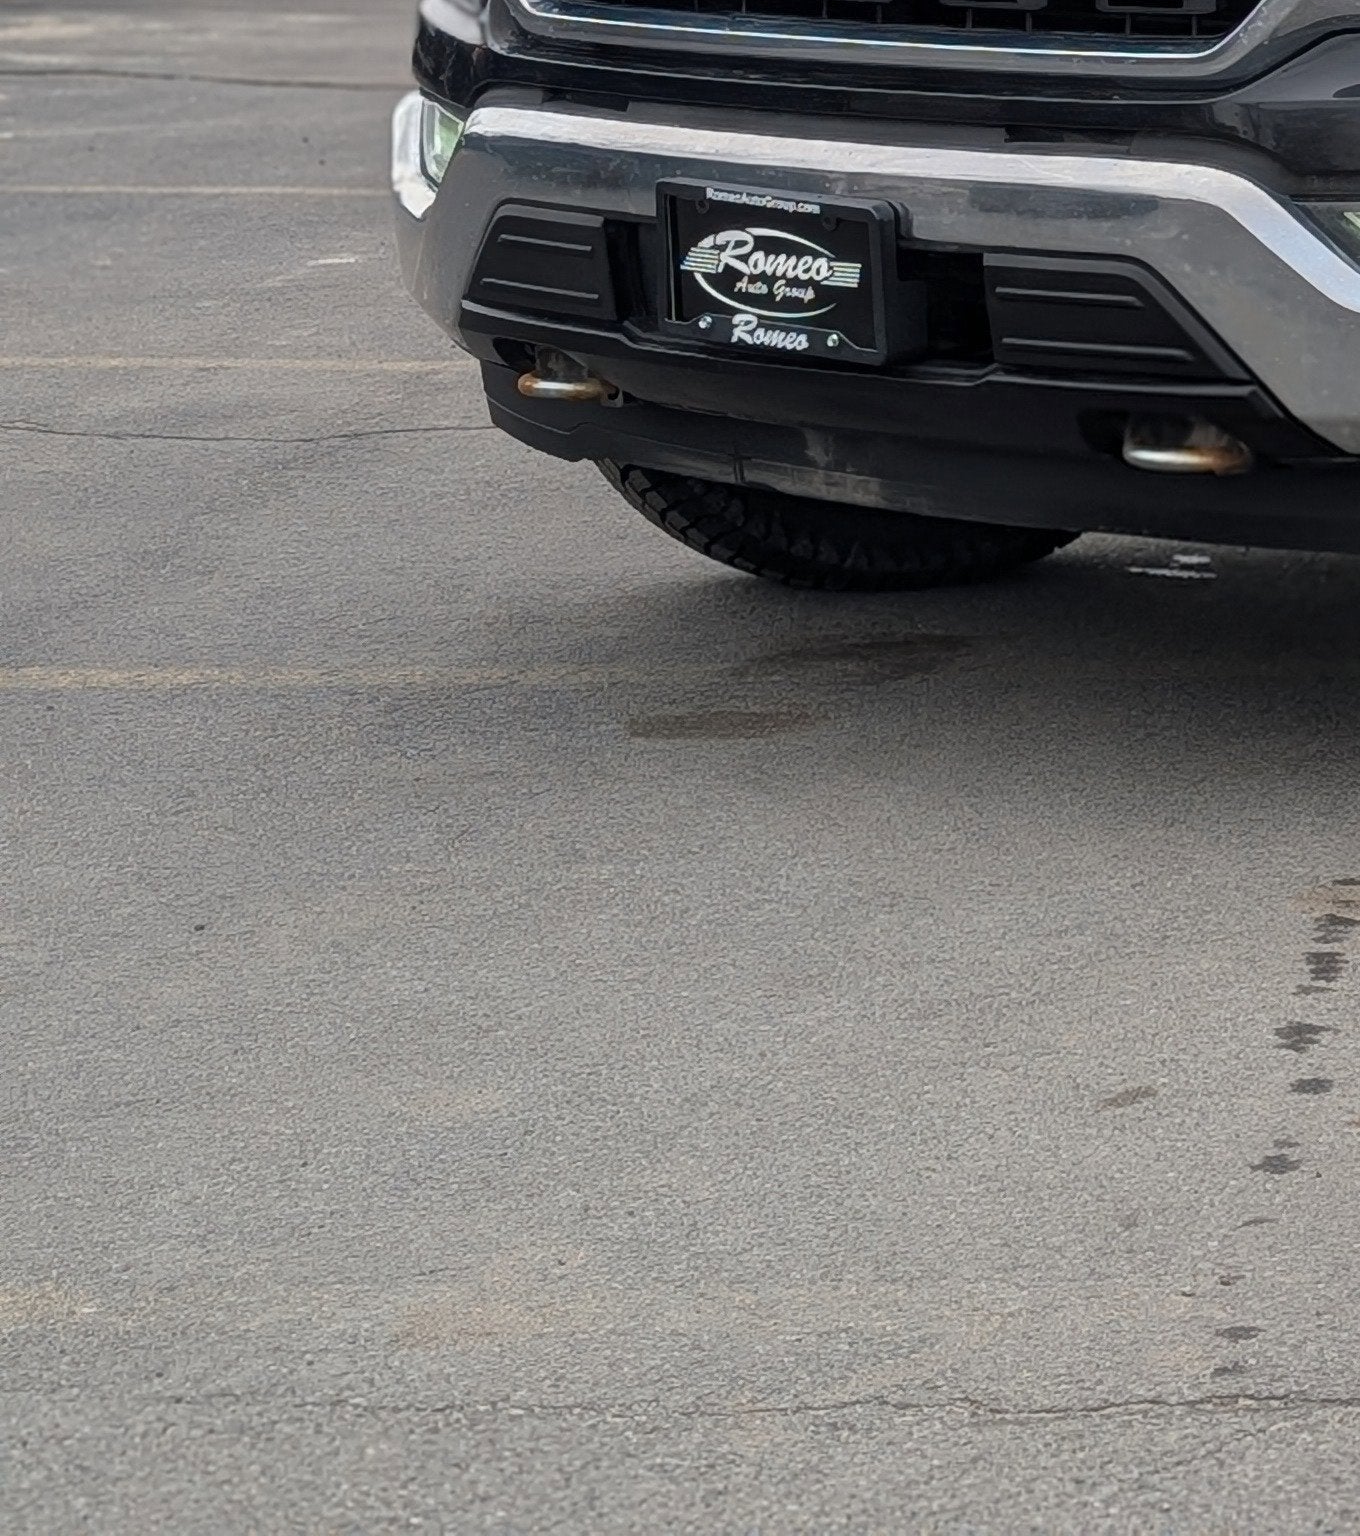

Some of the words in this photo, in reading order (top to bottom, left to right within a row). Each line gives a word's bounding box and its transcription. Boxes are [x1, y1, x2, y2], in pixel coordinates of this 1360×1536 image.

[715, 230, 835, 282] Romeo
[733, 275, 769, 295] Auto
[772, 279, 816, 304] Group
[730, 313, 810, 352] Romeo
